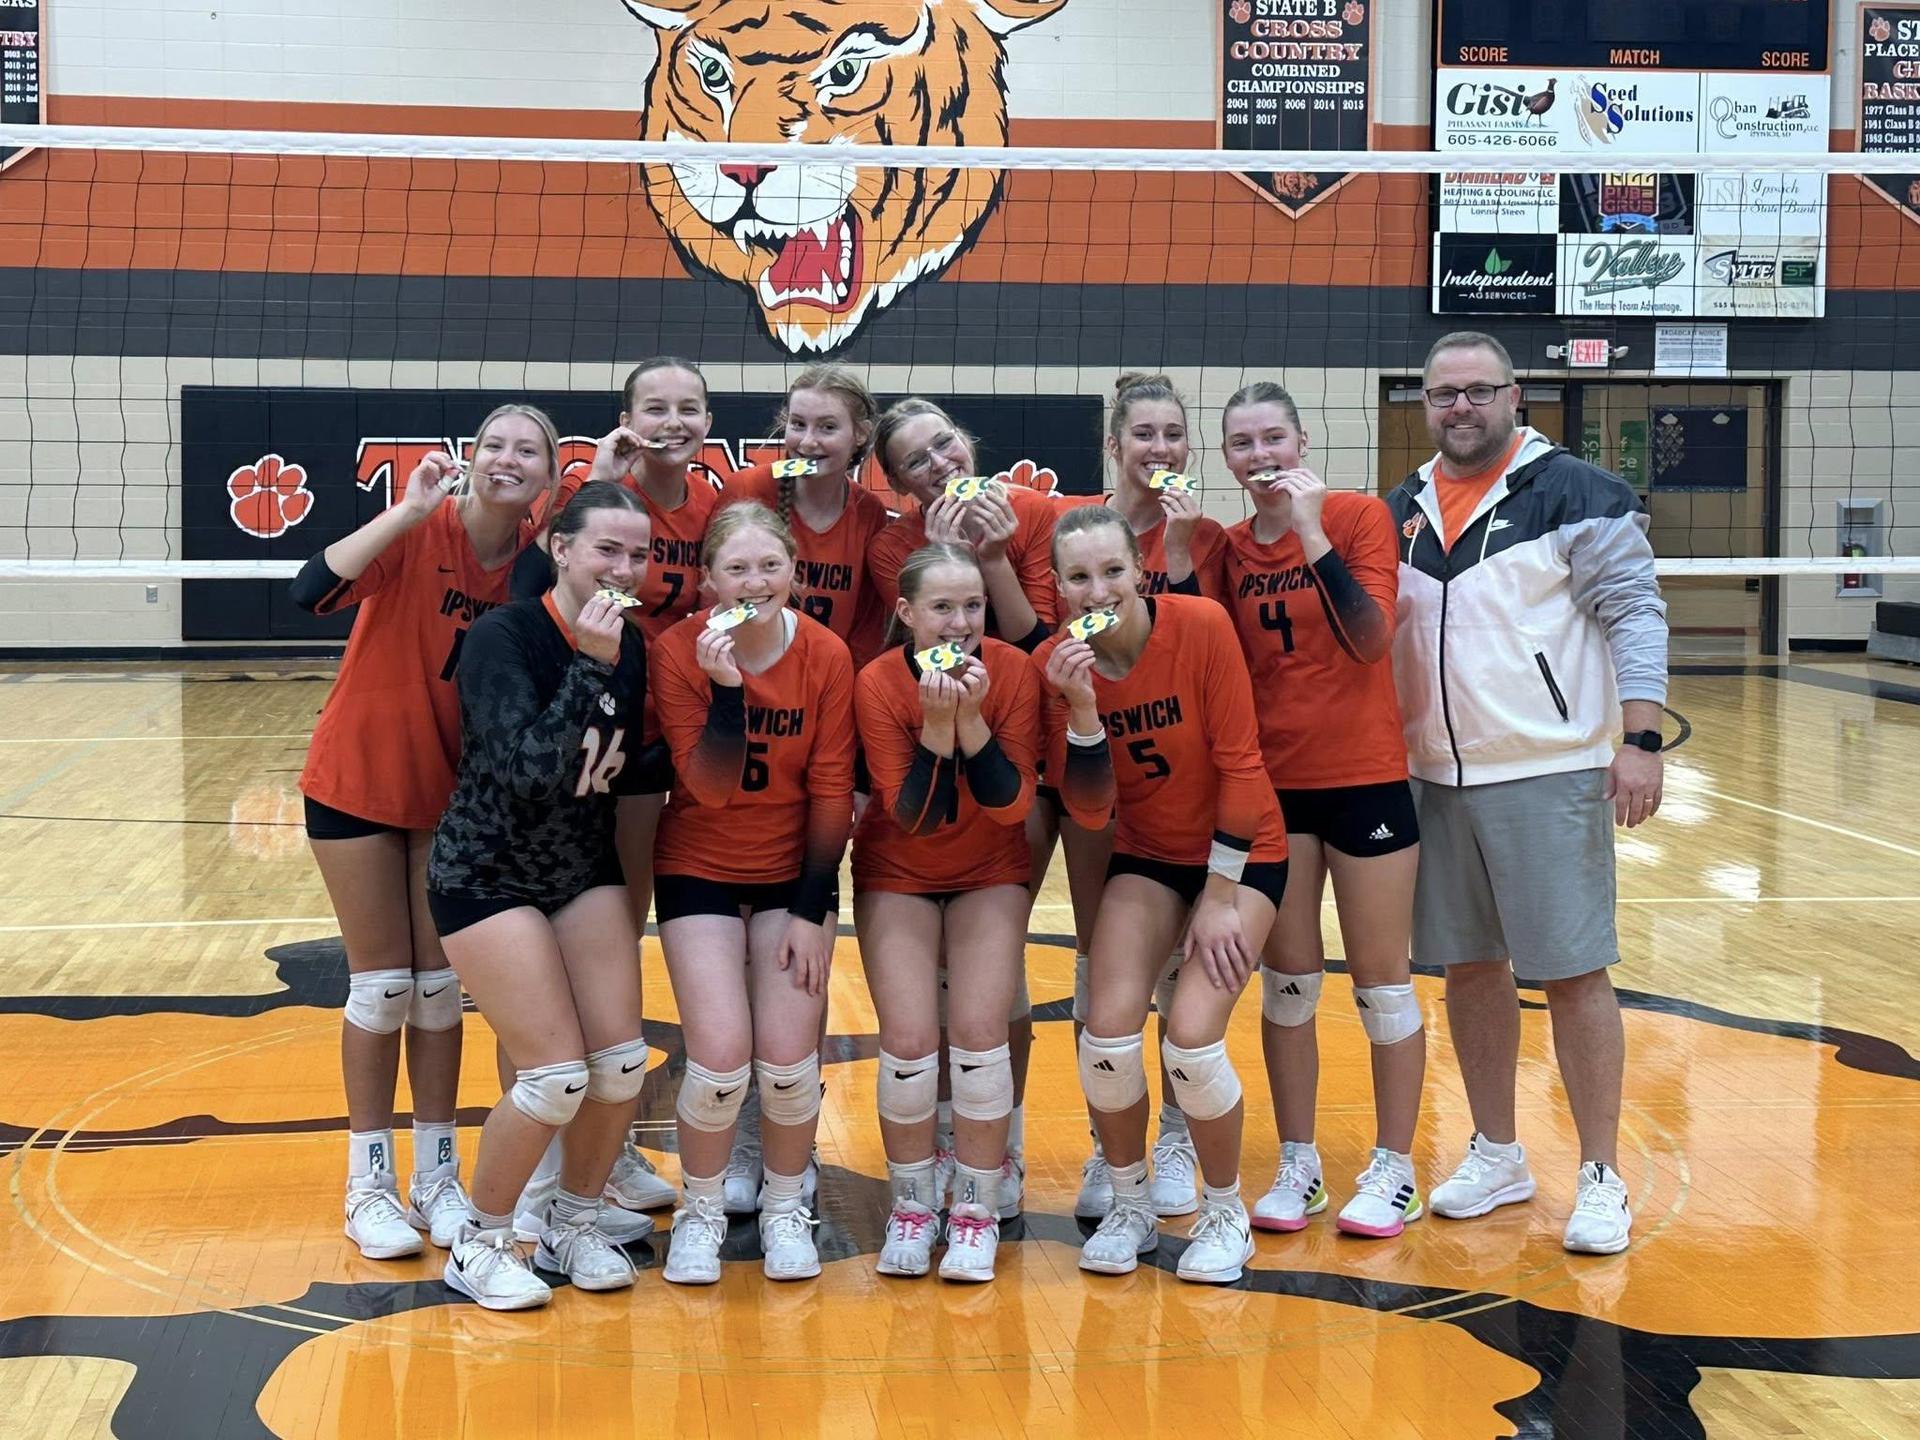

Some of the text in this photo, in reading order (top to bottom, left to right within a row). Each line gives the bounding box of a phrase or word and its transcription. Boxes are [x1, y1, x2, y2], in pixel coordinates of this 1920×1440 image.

[1256, 0, 1337, 16] STATE B
[1251, 19, 1343, 38] CROSS
[1231, 41, 1363, 61] COUNTRY
[1460, 46, 1508, 62] SCORE
[1610, 49, 1660, 65] MATCH
[1761, 51, 1809, 67] SCORE
[1252, 64, 1341, 78] COMBINED
[1227, 80, 1365, 95] CHAMPIONSHIPS
[1314, 100, 1335, 110] 2014
[1343, 100, 1364, 111] 2015
[1447, 82, 1526, 116] Gisi
[1590, 82, 1637, 114] Seed
[1865, 105, 1884, 115] 1977
[1885, 105, 1907, 115] Class
[1227, 114, 1277, 125] 2016 2017
[1607, 103, 1694, 134] Solutions
[1884, 119, 1907, 129] Class
[1447, 134, 1557, 147] 605-426-6066
[1884, 133, 1907, 143] Class
[1443, 188, 1483, 197] HEATING
[1485, 188, 1492, 197] &
[1494, 189, 1535, 198] COOLING
[1583, 240, 1686, 284] Valley
[1442, 269, 1554, 291] Independent
[1485, 291, 1527, 300] SERVICES
[1580, 300, 1593, 311] The
[1595, 300, 1617, 311] Home
[1619, 301, 1639, 311] Team
[1239, 564, 1315, 599] IPSWICH
[648, 571, 684, 618] 7
[1259, 599, 1296, 654] 4
[575, 726, 627, 798] 16
[740, 740, 770, 792] 6
[1126, 738, 1171, 780] 5
